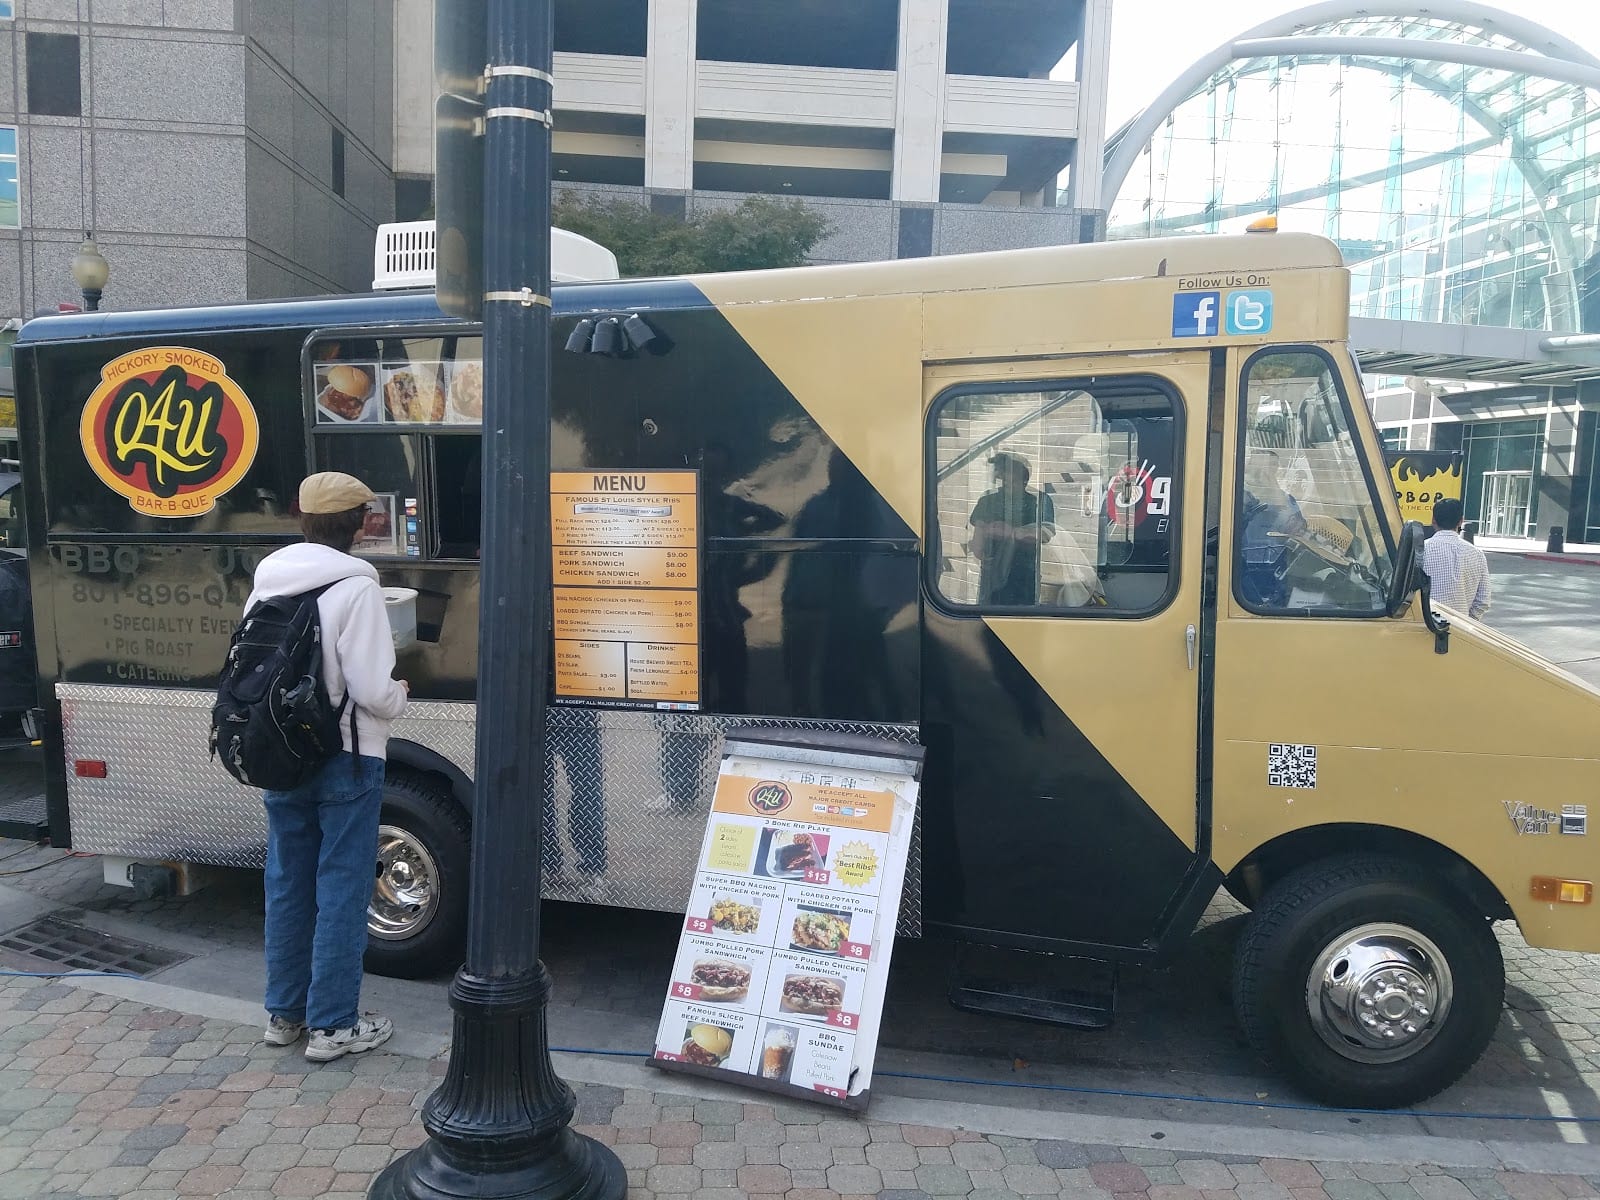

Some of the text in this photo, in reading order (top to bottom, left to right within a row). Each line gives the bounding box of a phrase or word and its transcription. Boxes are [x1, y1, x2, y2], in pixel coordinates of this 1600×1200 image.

[1178, 274, 1270, 289] Follow Us On:
[593, 475, 646, 491] MENU
[136, 494, 209, 511] BAR-B-QUE
[60, 545, 140, 576] BBQ
[72, 582, 242, 609] 801-896-Q4
[113, 613, 241, 635] SPECIALTY EVEN
[115, 638, 193, 657] PIG ROAST
[116, 663, 192, 682] CATERING
[1501, 800, 1557, 822] Value
[771, 820, 791, 828] BONE
[807, 824, 831, 833] PLATE
[1511, 817, 1551, 836] Van
[807, 870, 827, 881] $13
[845, 870, 864, 878] Award
[705, 876, 777, 891] SUPER BBQ NACHOS
[718, 886, 749, 894] CHICKEN
[800, 890, 860, 905] LOADED POTATO
[787, 896, 806, 904] WITH
[807, 899, 840, 909] CHICKEN
[854, 907, 874, 915] PORK
[692, 919, 707, 931] $9
[690, 938, 765, 955] JUMBO PULLED PORK
[704, 948, 747, 960] SANDWHICH
[850, 944, 863, 956] $8
[773, 952, 866, 973] JUMBO PULLED CHICKEN
[794, 963, 841, 977] SANDWHICH
[677, 984, 692, 996] $8
[687, 1005, 744, 1022] FAMOUS SLICED
[835, 1012, 852, 1026] $8
[681, 1013, 744, 1030] BEEF SANDWHICH
[818, 1033, 837, 1042] BBQ
[808, 1039, 845, 1052] SUNDAE
